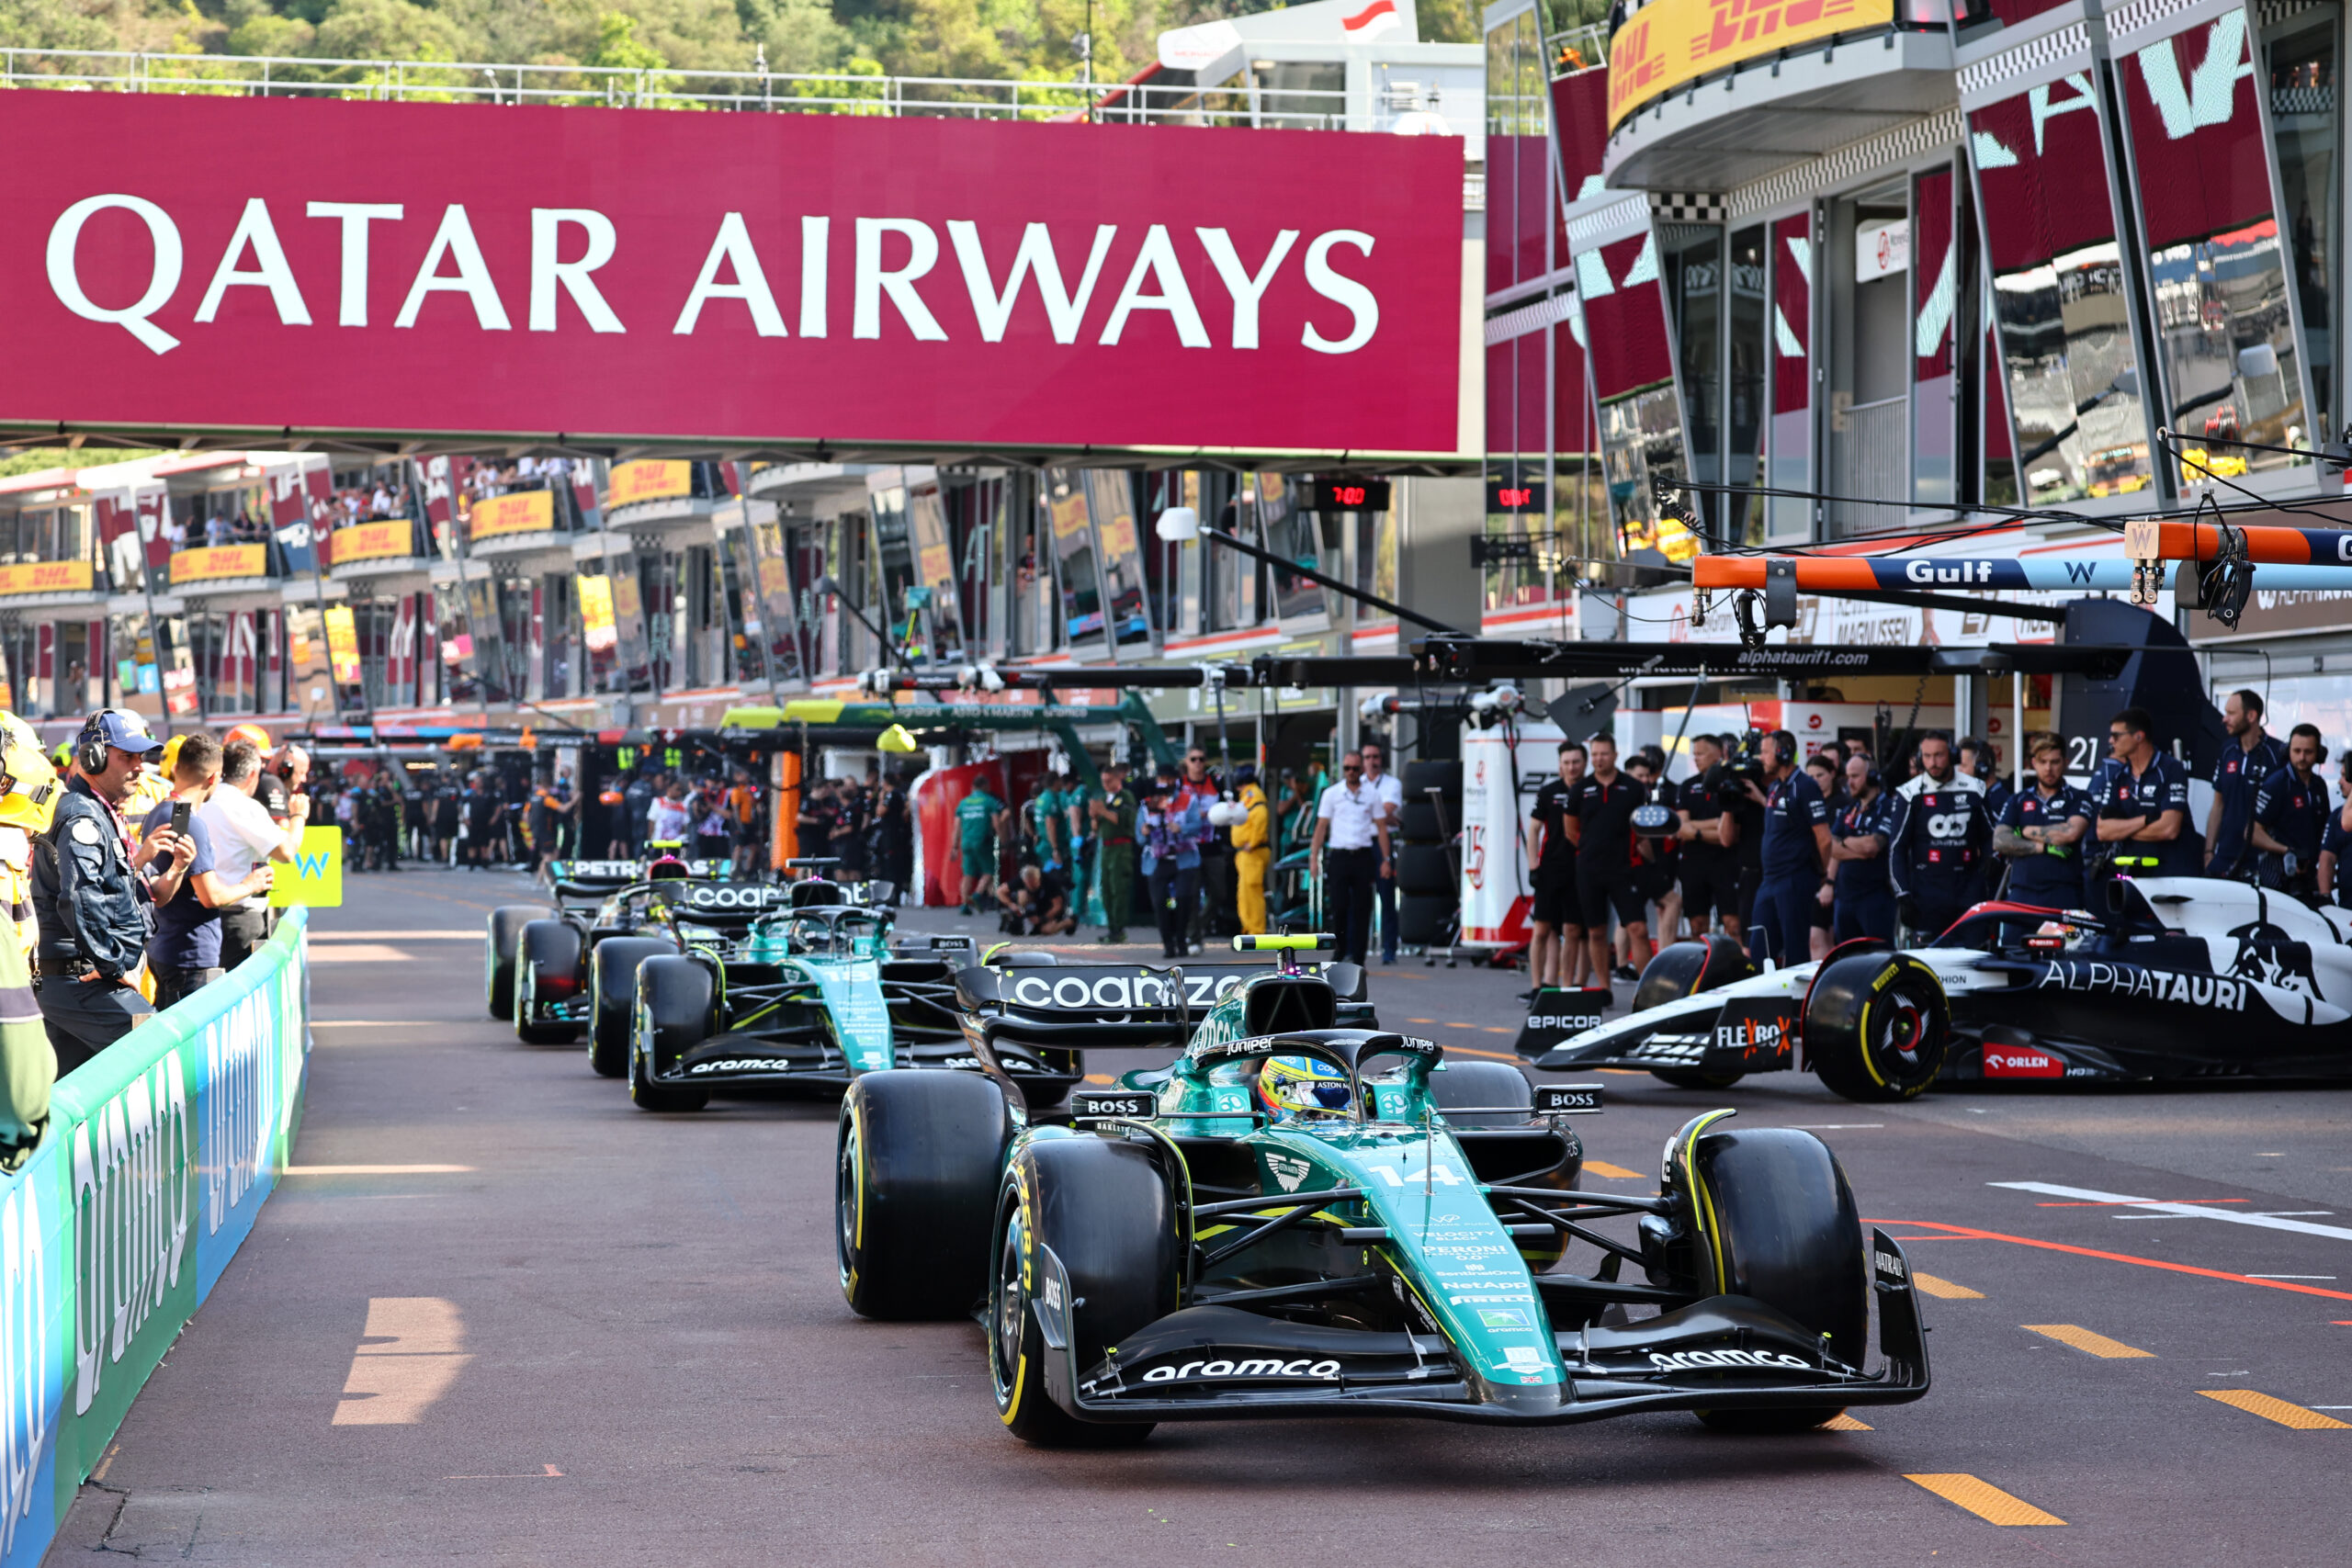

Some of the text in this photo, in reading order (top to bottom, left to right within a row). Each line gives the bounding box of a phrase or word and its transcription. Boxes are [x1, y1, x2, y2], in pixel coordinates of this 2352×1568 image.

[46, 194, 1380, 355] QATAR AIRWAYS
[1332, 487, 1365, 505] 7:00
[1906, 559, 1992, 582] Gulf
[1737, 649, 1869, 666] alphataurif1.com
[2068, 737, 2098, 771] 21
[2039, 960, 2246, 1011] ALPHATAURI
[1716, 1016, 1791, 1059] FLEXBOX
[691, 1059, 788, 1073] aramco
[2007, 1056, 2049, 1068] ORLEN
[1088, 1100, 1138, 1113] BOSS
[1551, 1093, 1594, 1106] BOSS
[1367, 1164, 1465, 1187] 14
[74, 1044, 187, 1417] aramco
[1421, 1245, 1508, 1253] PERONI
[1046, 1277, 1061, 1311] BOSS
[1442, 1282, 1529, 1291] NetApp
[1449, 1294, 1535, 1305] PIRELLI
[1649, 1349, 1812, 1369] aramco
[1143, 1359, 1341, 1382] aramco
